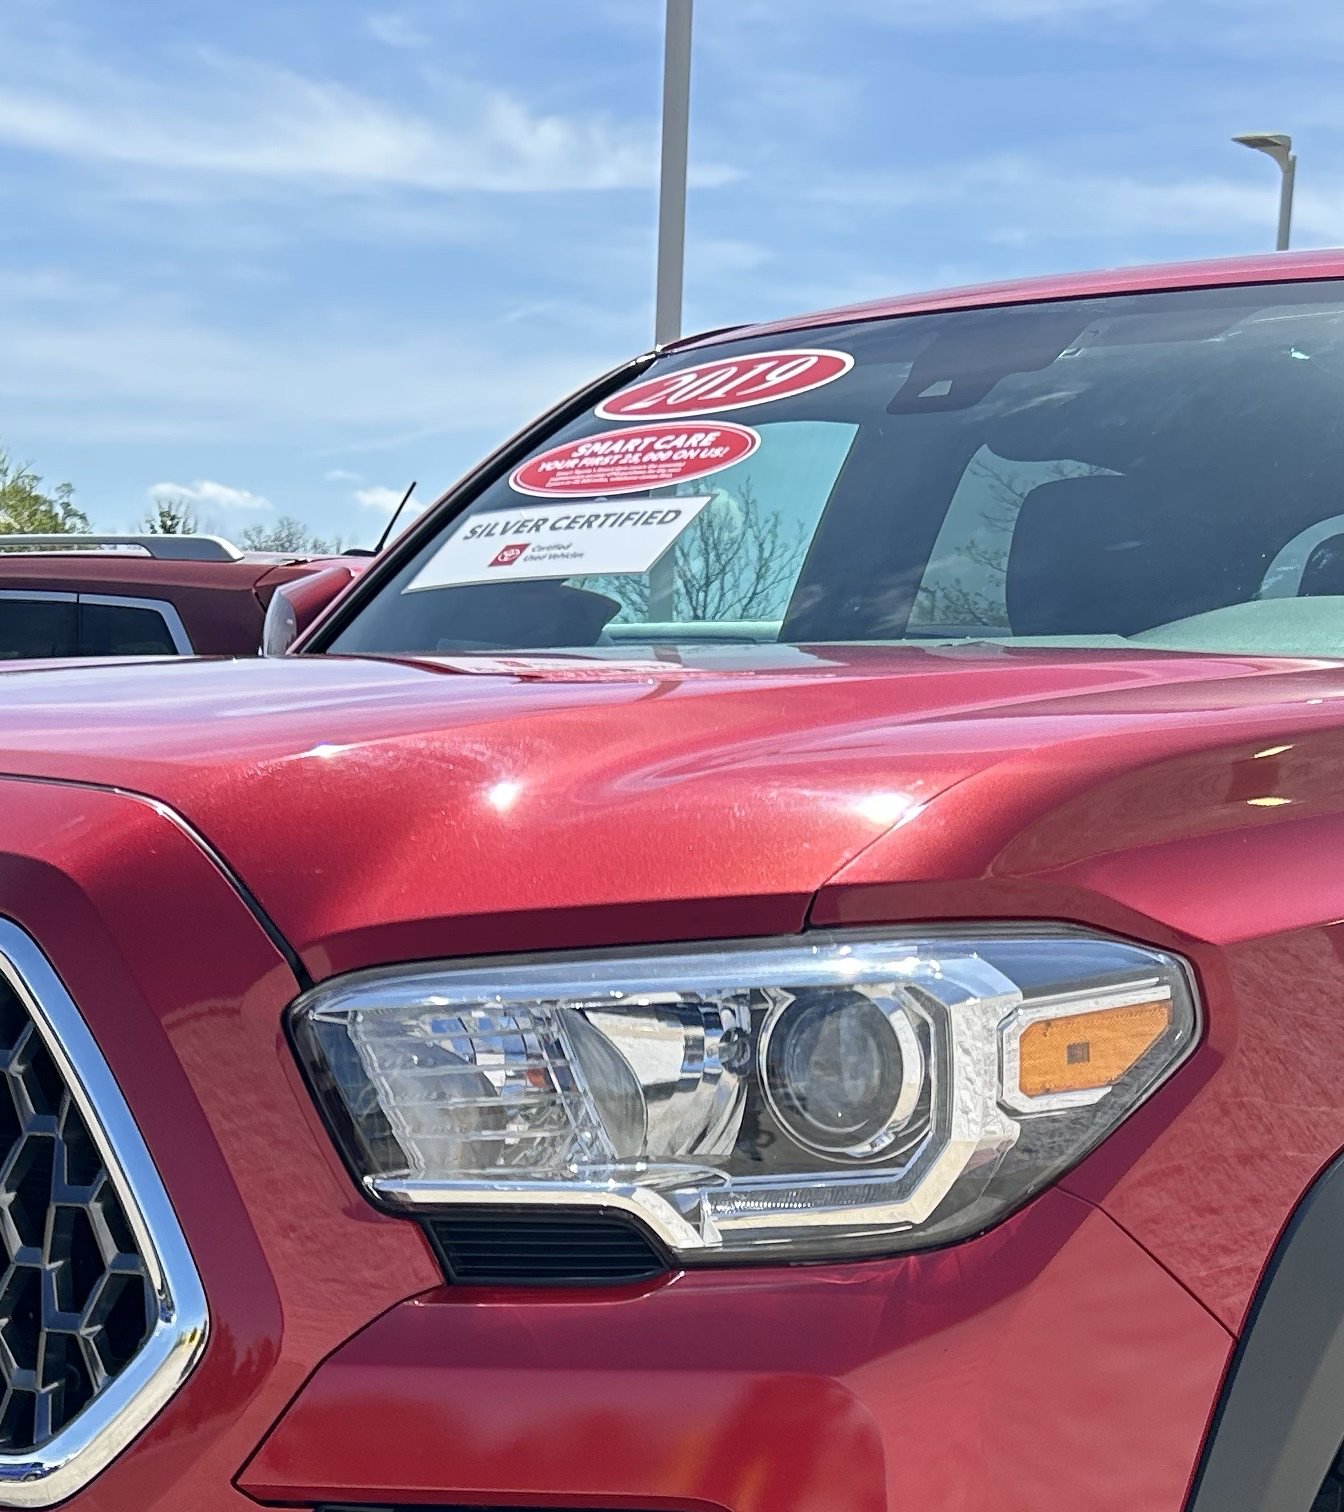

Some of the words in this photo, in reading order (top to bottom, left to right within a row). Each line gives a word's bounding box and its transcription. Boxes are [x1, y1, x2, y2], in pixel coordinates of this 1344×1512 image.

[620, 356, 819, 412] 2019
[572, 436, 655, 457] SMART
[654, 431, 721, 449] CARE
[538, 460, 581, 473] YOUR
[578, 454, 620, 467] FIRST
[671, 448, 701, 461] ON
[699, 446, 730, 459] US!
[463, 517, 549, 540] SILVER
[549, 509, 682, 532] CERTIFIED
